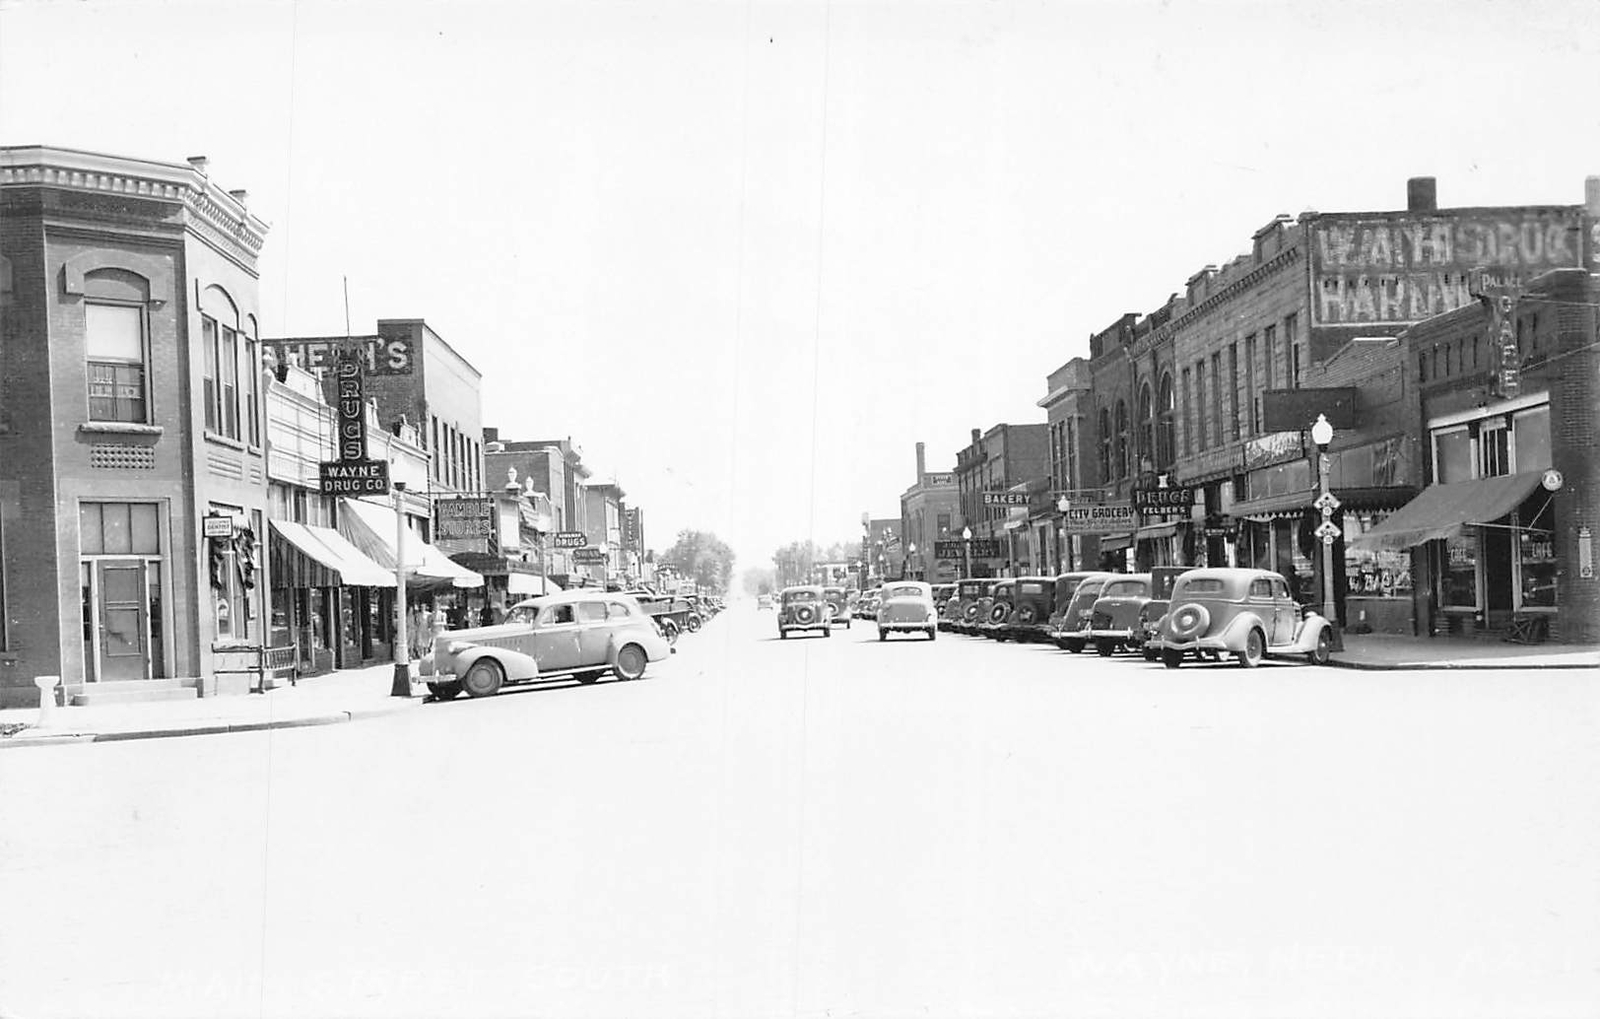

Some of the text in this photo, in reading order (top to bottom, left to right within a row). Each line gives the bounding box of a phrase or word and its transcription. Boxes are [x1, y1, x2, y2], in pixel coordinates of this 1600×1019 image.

[1500, 295, 1518, 387] CAFE
[340, 360, 361, 461] DRUGS
[328, 465, 380, 478] WAYNE
[324, 480, 360, 492] DRUG
[984, 494, 1031, 504] BAKERY
[1069, 505, 1135, 519] CITY GROCERY
[555, 537, 585, 547] DRUGS
